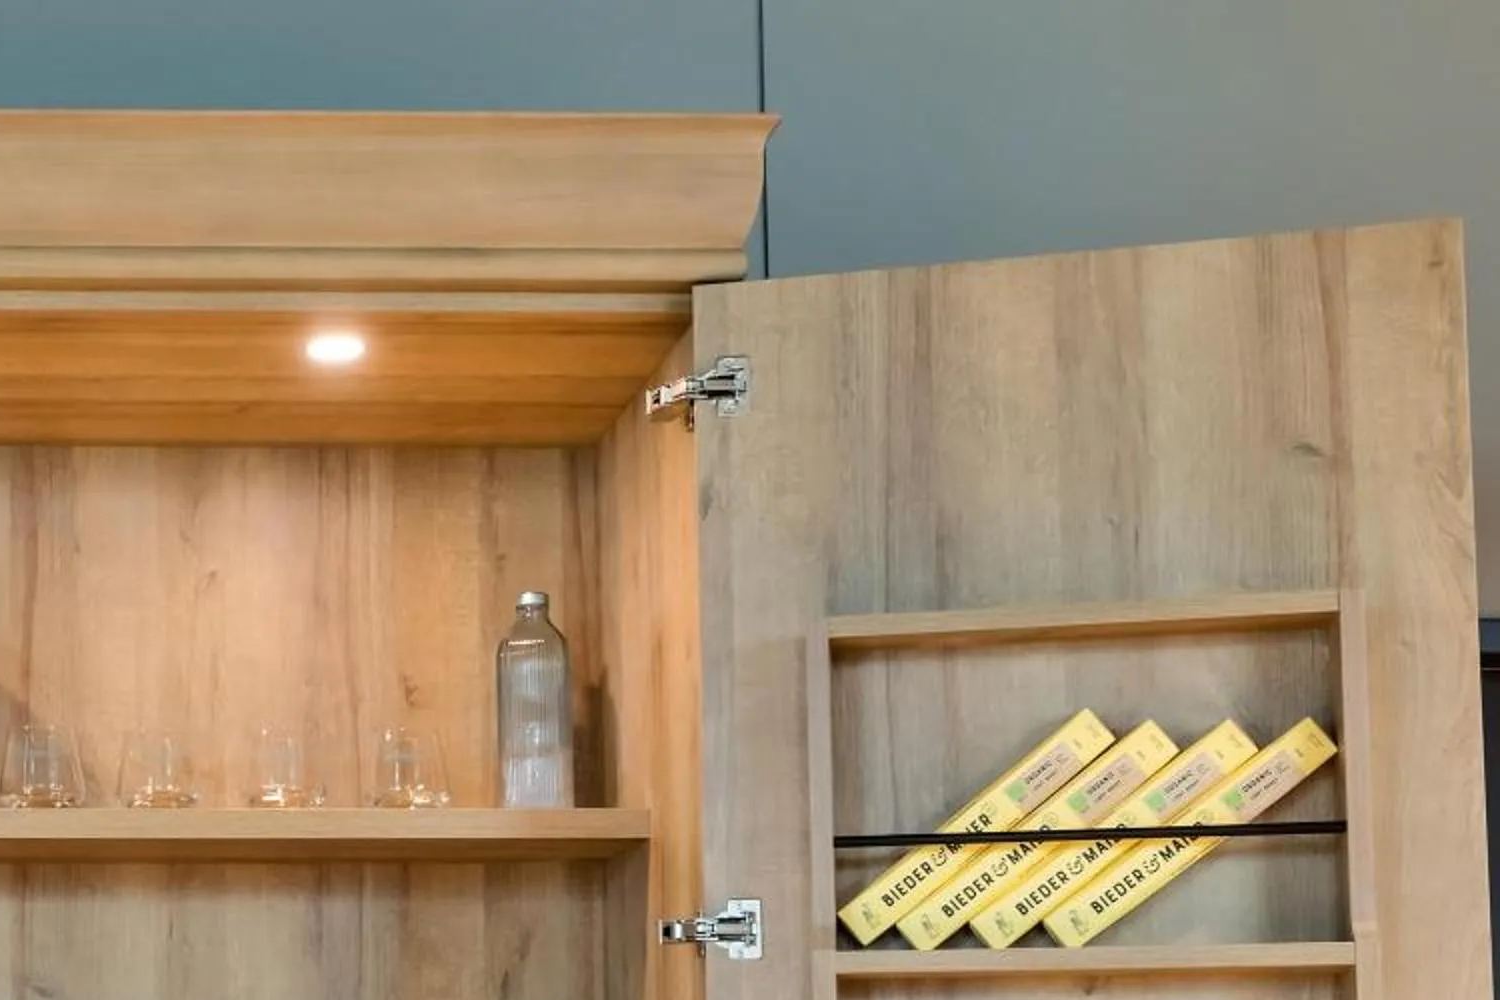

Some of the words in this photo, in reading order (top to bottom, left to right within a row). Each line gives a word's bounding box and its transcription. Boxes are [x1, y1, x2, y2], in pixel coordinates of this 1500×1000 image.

[881, 861, 935, 907] BIEDER
[945, 813, 993, 856] MER
[941, 872, 995, 918] BIEDER
[1007, 824, 1051, 865] MAI
[1015, 870, 1071, 916] BIEDER
[1082, 823, 1127, 864] MAI
[1090, 868, 1147, 914] BIEDER
[1159, 821, 1203, 863] MAI
